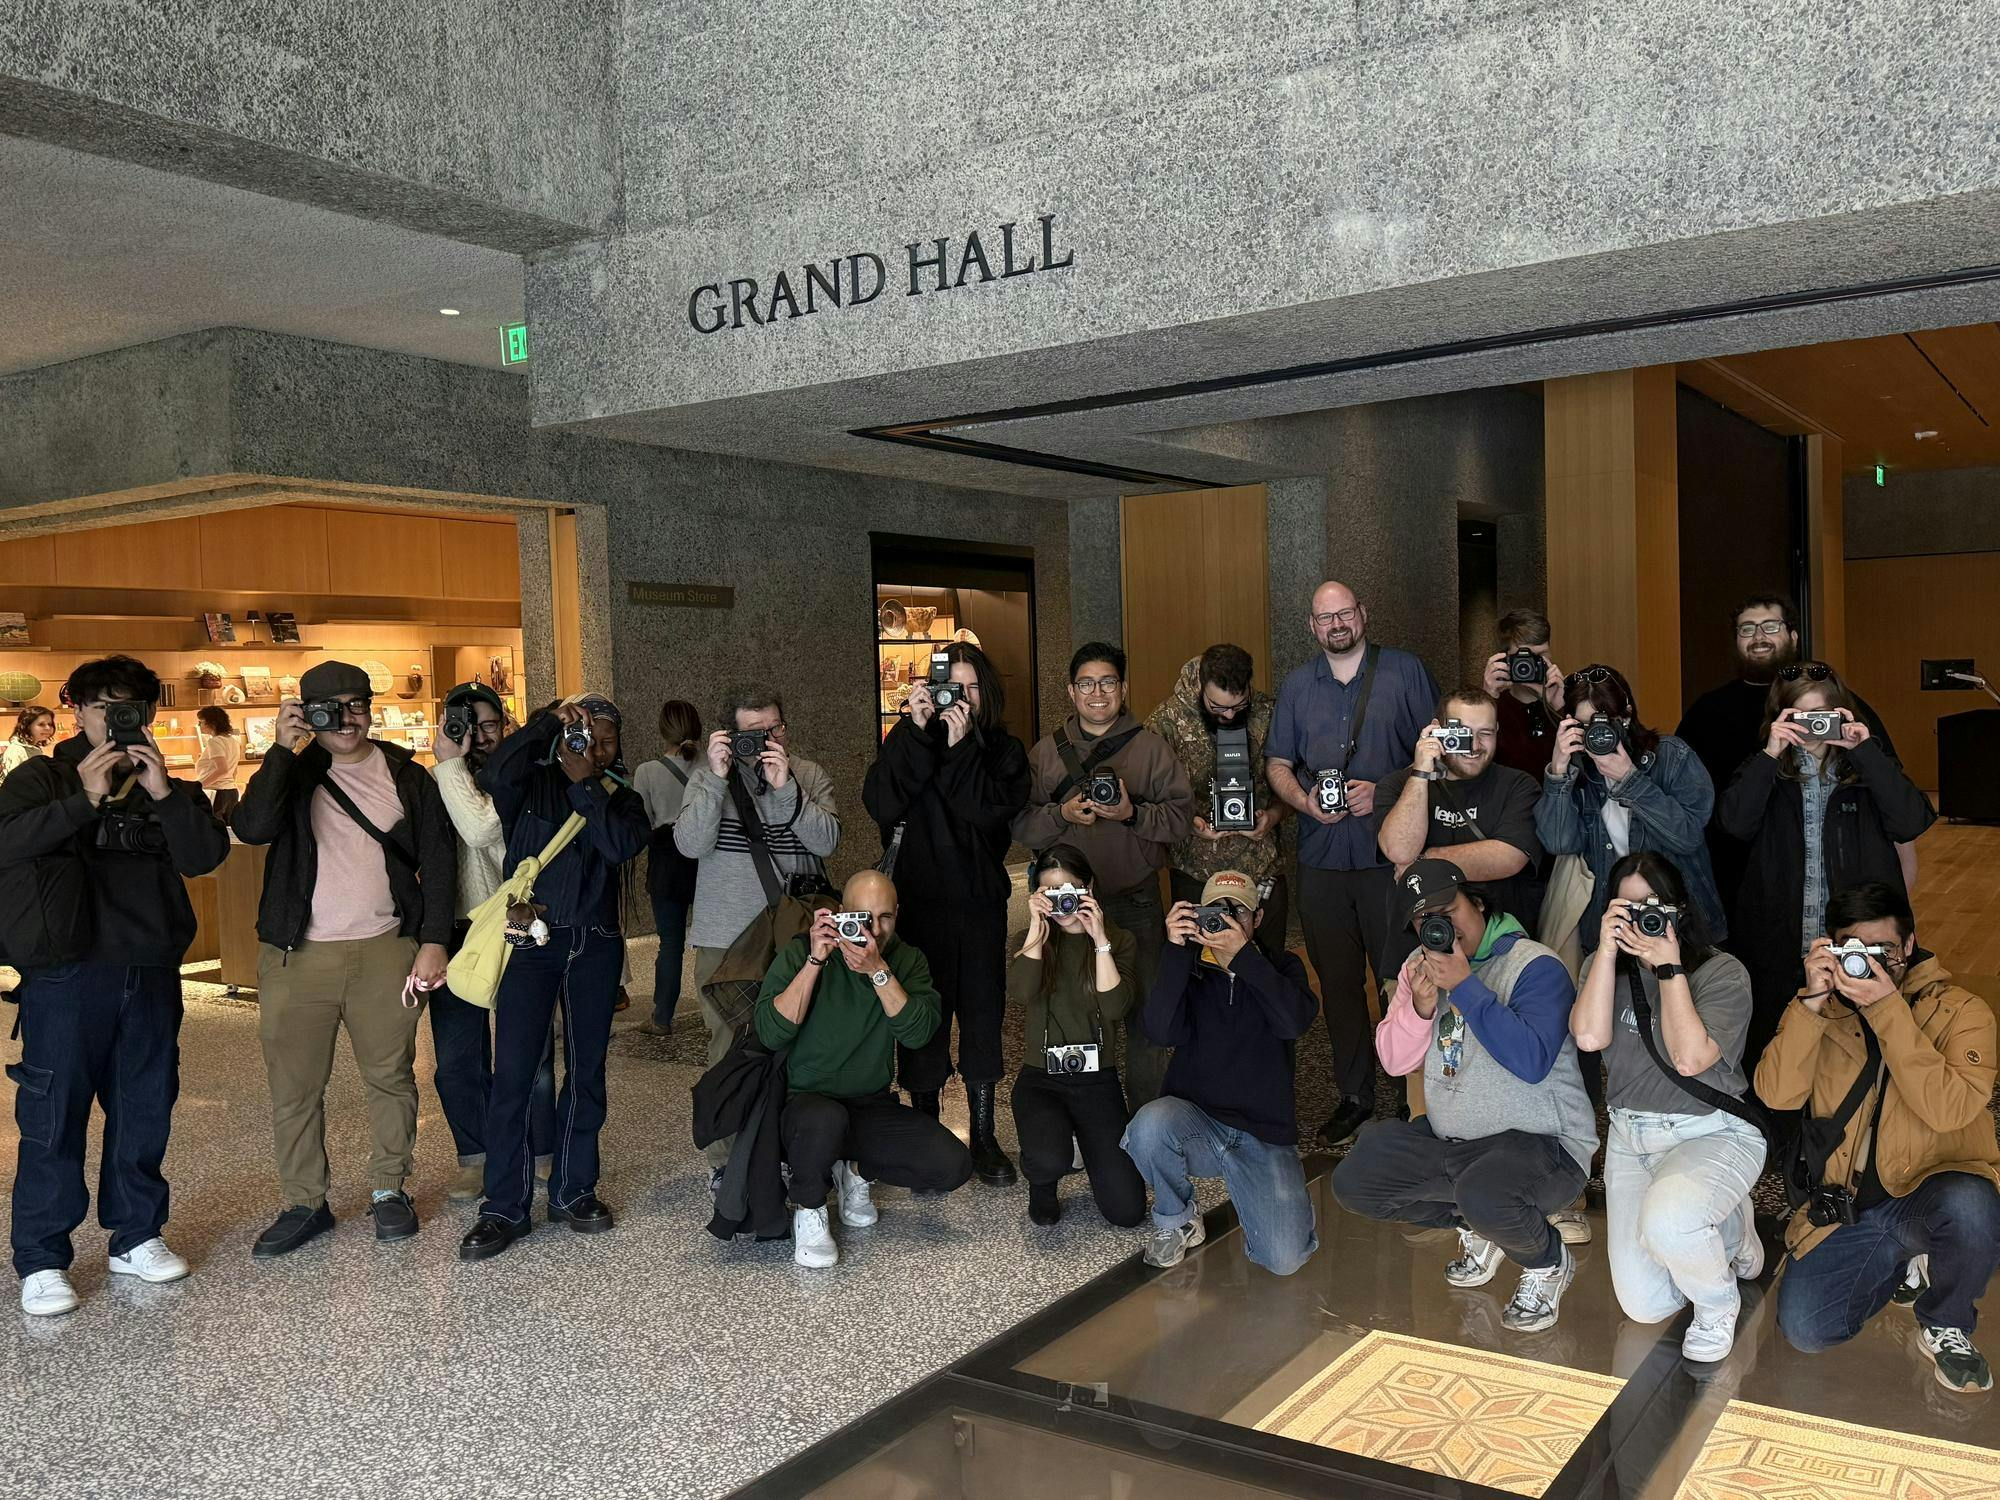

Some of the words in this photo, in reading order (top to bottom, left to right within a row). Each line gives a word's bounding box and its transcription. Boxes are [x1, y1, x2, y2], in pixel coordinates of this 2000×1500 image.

[688, 252, 886, 333] GRAND
[905, 214, 1074, 296] HALL
[632, 587, 684, 602] Museum
[687, 590, 717, 603] Store
